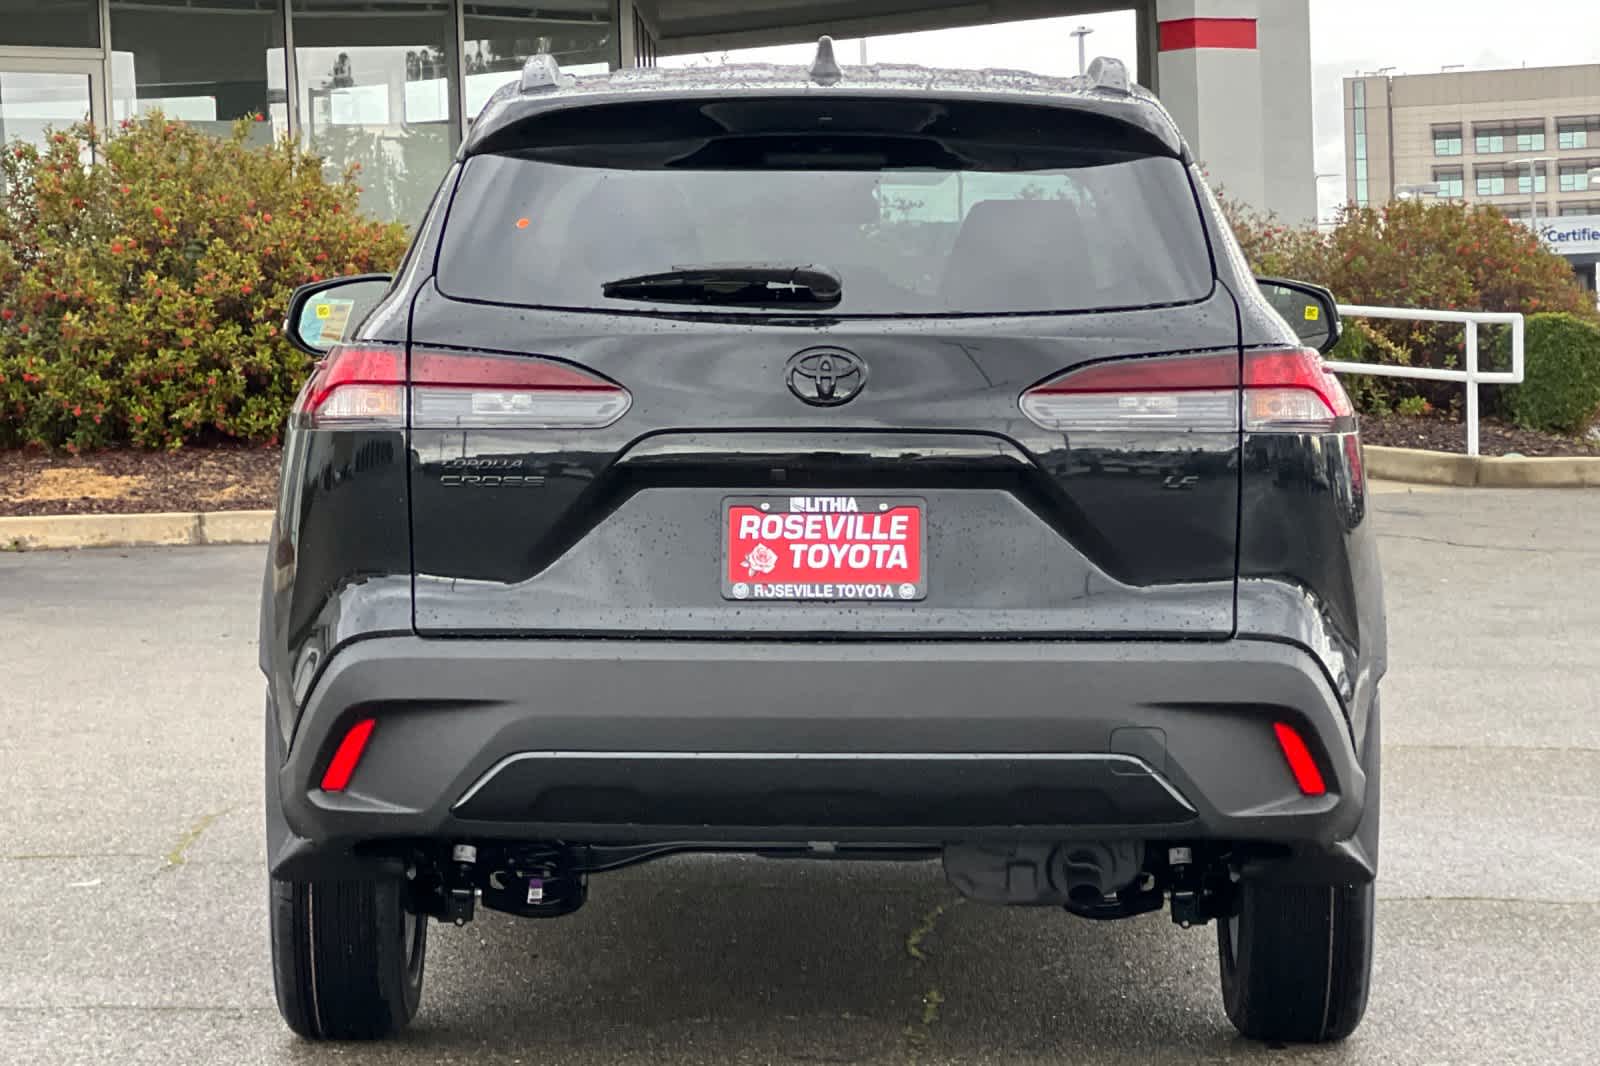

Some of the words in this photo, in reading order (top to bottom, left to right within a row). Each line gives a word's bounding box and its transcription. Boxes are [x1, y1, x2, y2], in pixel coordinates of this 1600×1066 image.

[440, 475, 545, 487] CROSS
[804, 497, 858, 513] LITHIA
[739, 514, 909, 540] ROSEVILLE
[789, 543, 908, 569] TOYOTA
[754, 584, 834, 598] ROSEVILLE
[836, 584, 893, 598] TOYOTA
